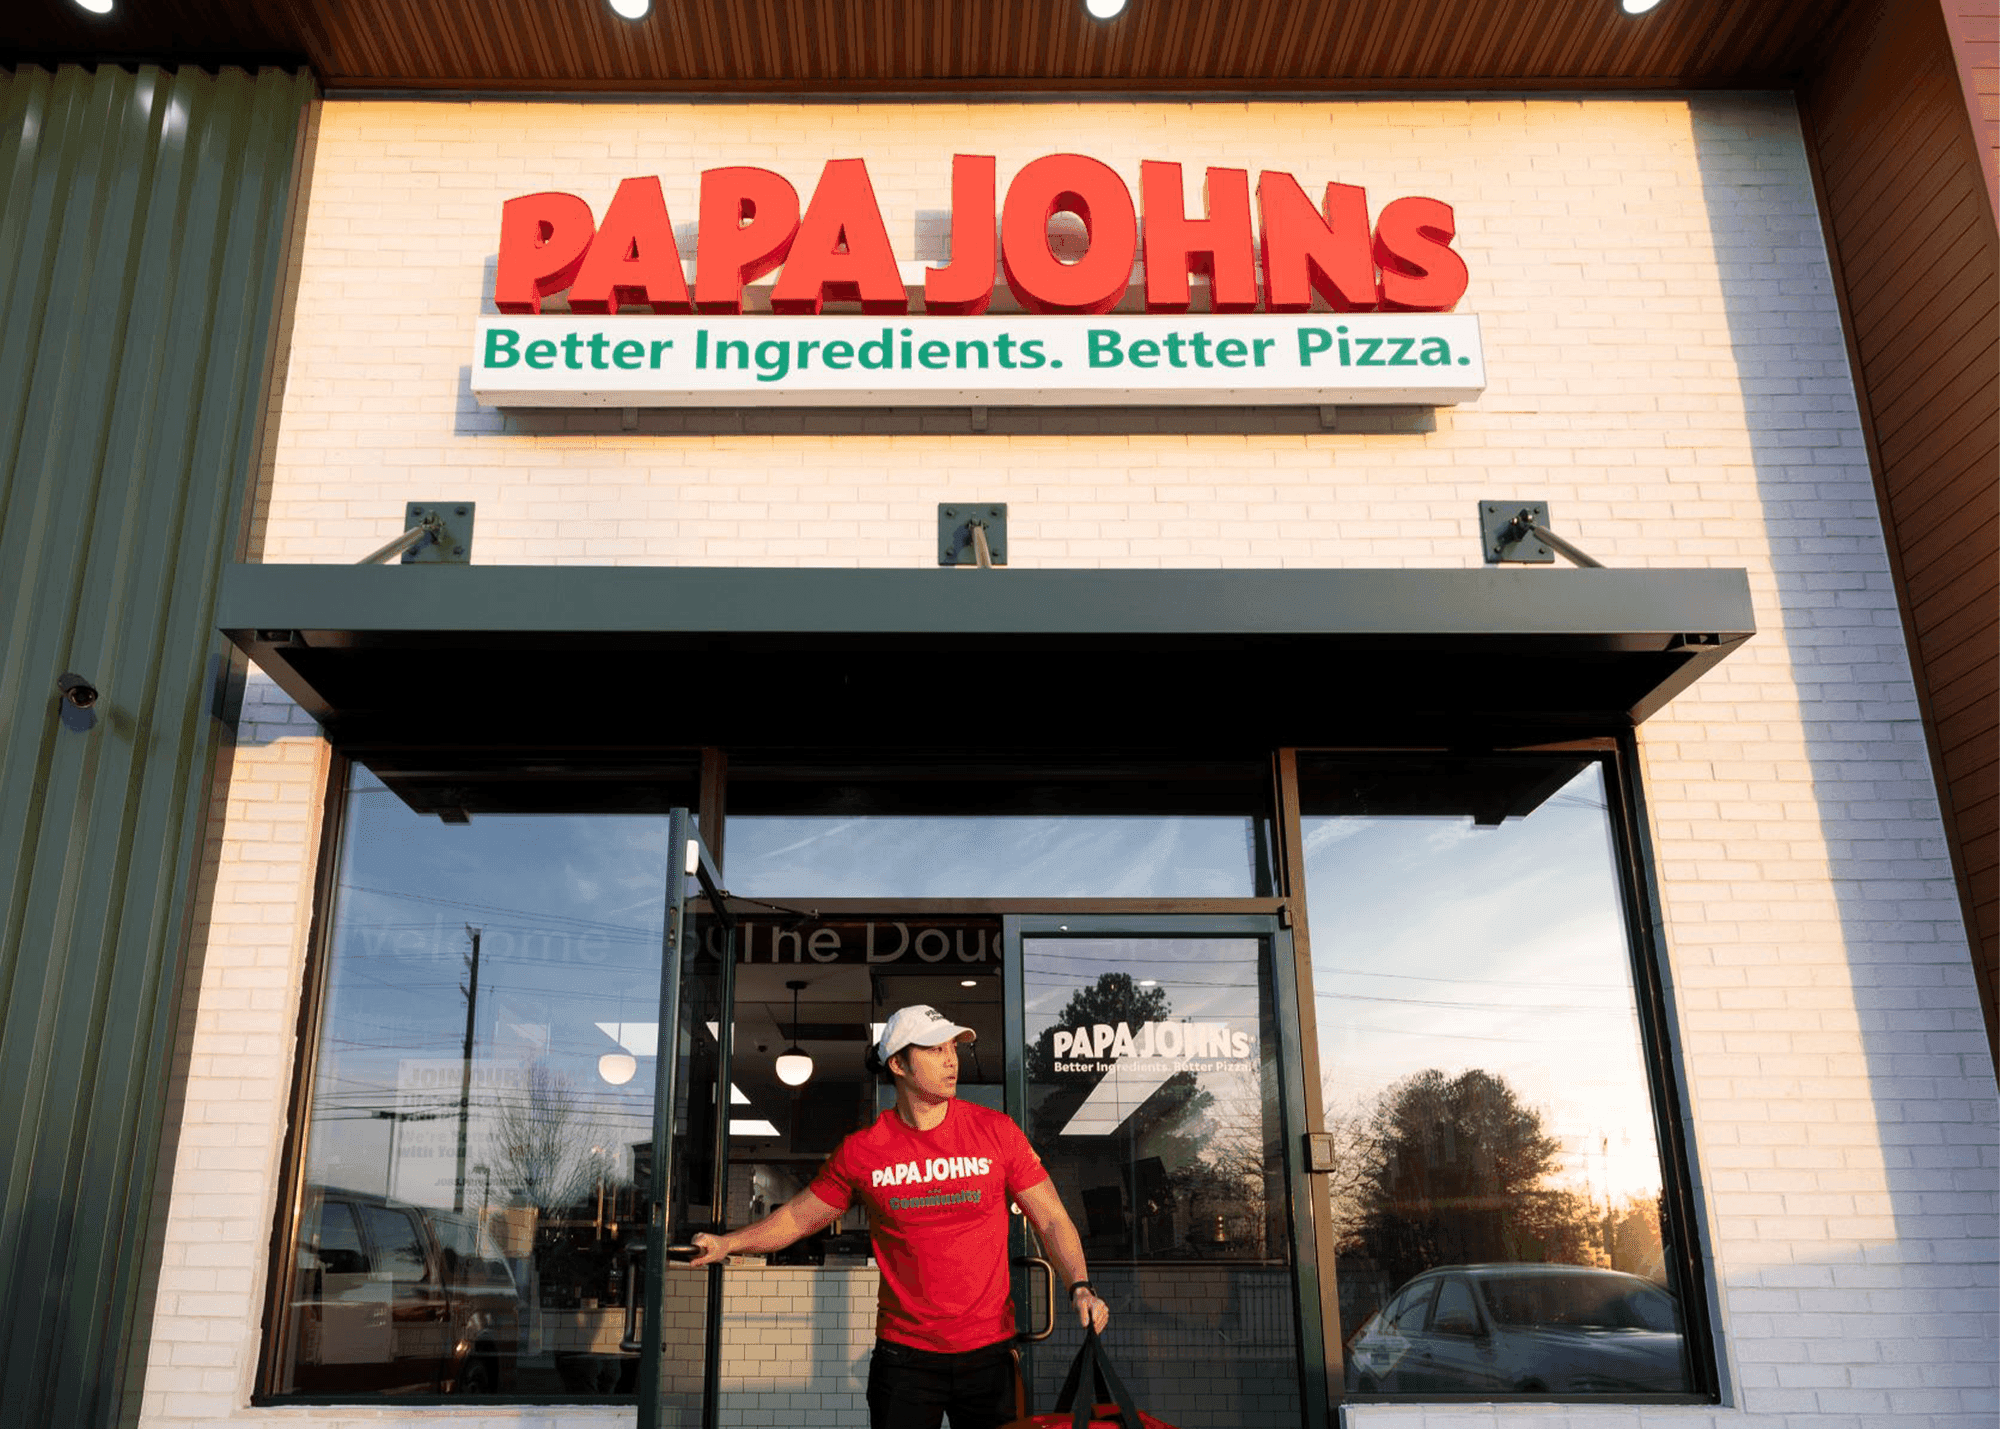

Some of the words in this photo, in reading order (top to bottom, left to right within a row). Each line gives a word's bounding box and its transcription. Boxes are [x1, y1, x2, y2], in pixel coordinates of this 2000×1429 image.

[494, 157, 908, 314] PAPA
[925, 153, 1469, 314] JOHNS
[482, 328, 674, 370] Better
[695, 327, 1064, 382] Ingredients.
[1087, 328, 1276, 369] Better
[1297, 325, 1471, 367] Pizza.
[866, 922, 1002, 963] Dou
[1053, 1021, 1137, 1058] PAPA
[1053, 1061, 1094, 1072] Better
[1096, 1061, 1171, 1074] Ingredients.
[1173, 1061, 1213, 1072] Better
[1216, 1061, 1252, 1072] Pizza.
[872, 1161, 924, 1187] PAPA
[889, 1189, 981, 1210] Community
